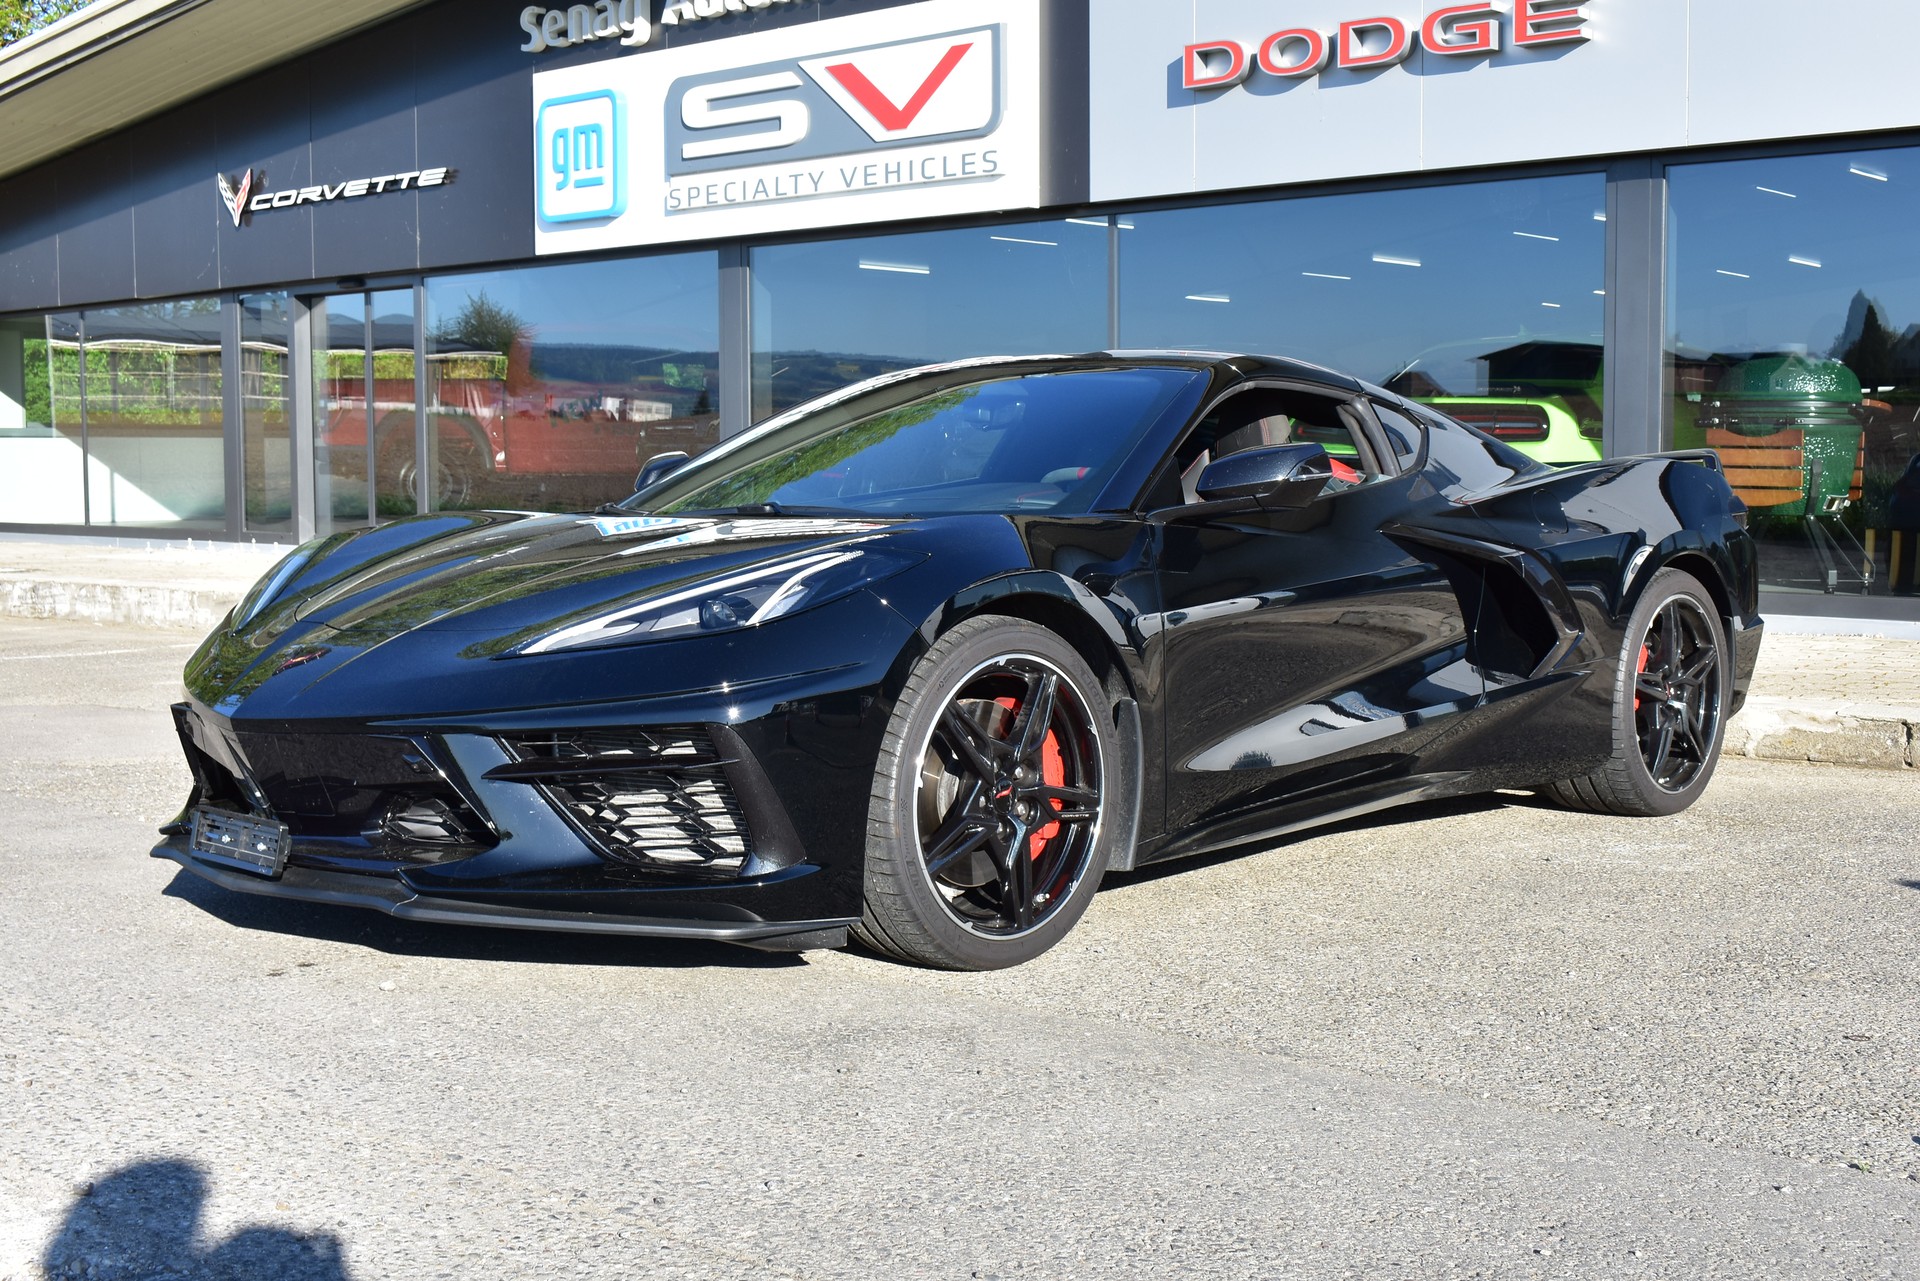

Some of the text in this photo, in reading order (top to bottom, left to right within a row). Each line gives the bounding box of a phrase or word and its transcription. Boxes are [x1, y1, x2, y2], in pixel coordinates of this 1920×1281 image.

[520, 0, 651, 53] Senag
[1182, 0, 1592, 89] DODGE
[681, 42, 975, 160] SV
[250, 166, 448, 211] CORVETTE
[552, 123, 604, 191] gm
[668, 149, 998, 209] SPECIALTY VEHICLES
